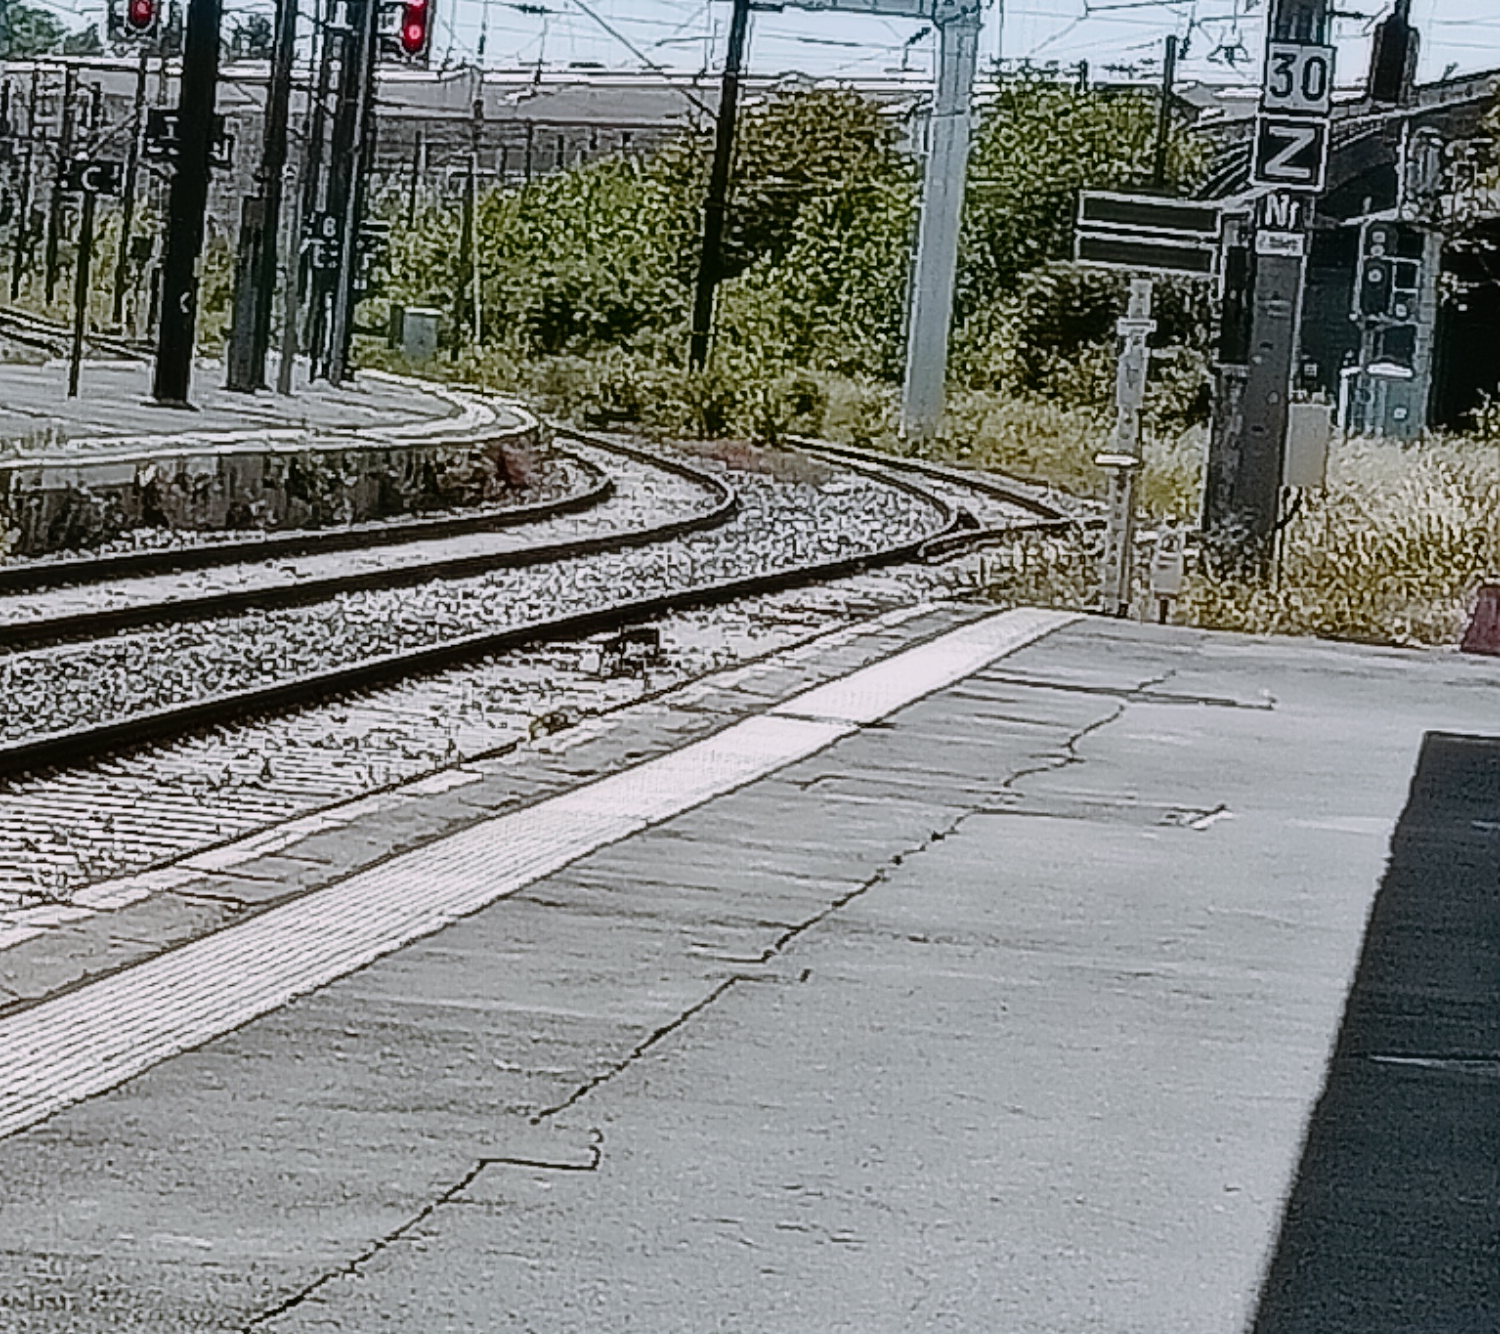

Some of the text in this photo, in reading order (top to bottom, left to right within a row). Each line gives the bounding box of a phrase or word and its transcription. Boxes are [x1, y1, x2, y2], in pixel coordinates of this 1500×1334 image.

[1268, 52, 1327, 102] 30
[1265, 125, 1316, 179] Z
[81, 166, 102, 192] C
